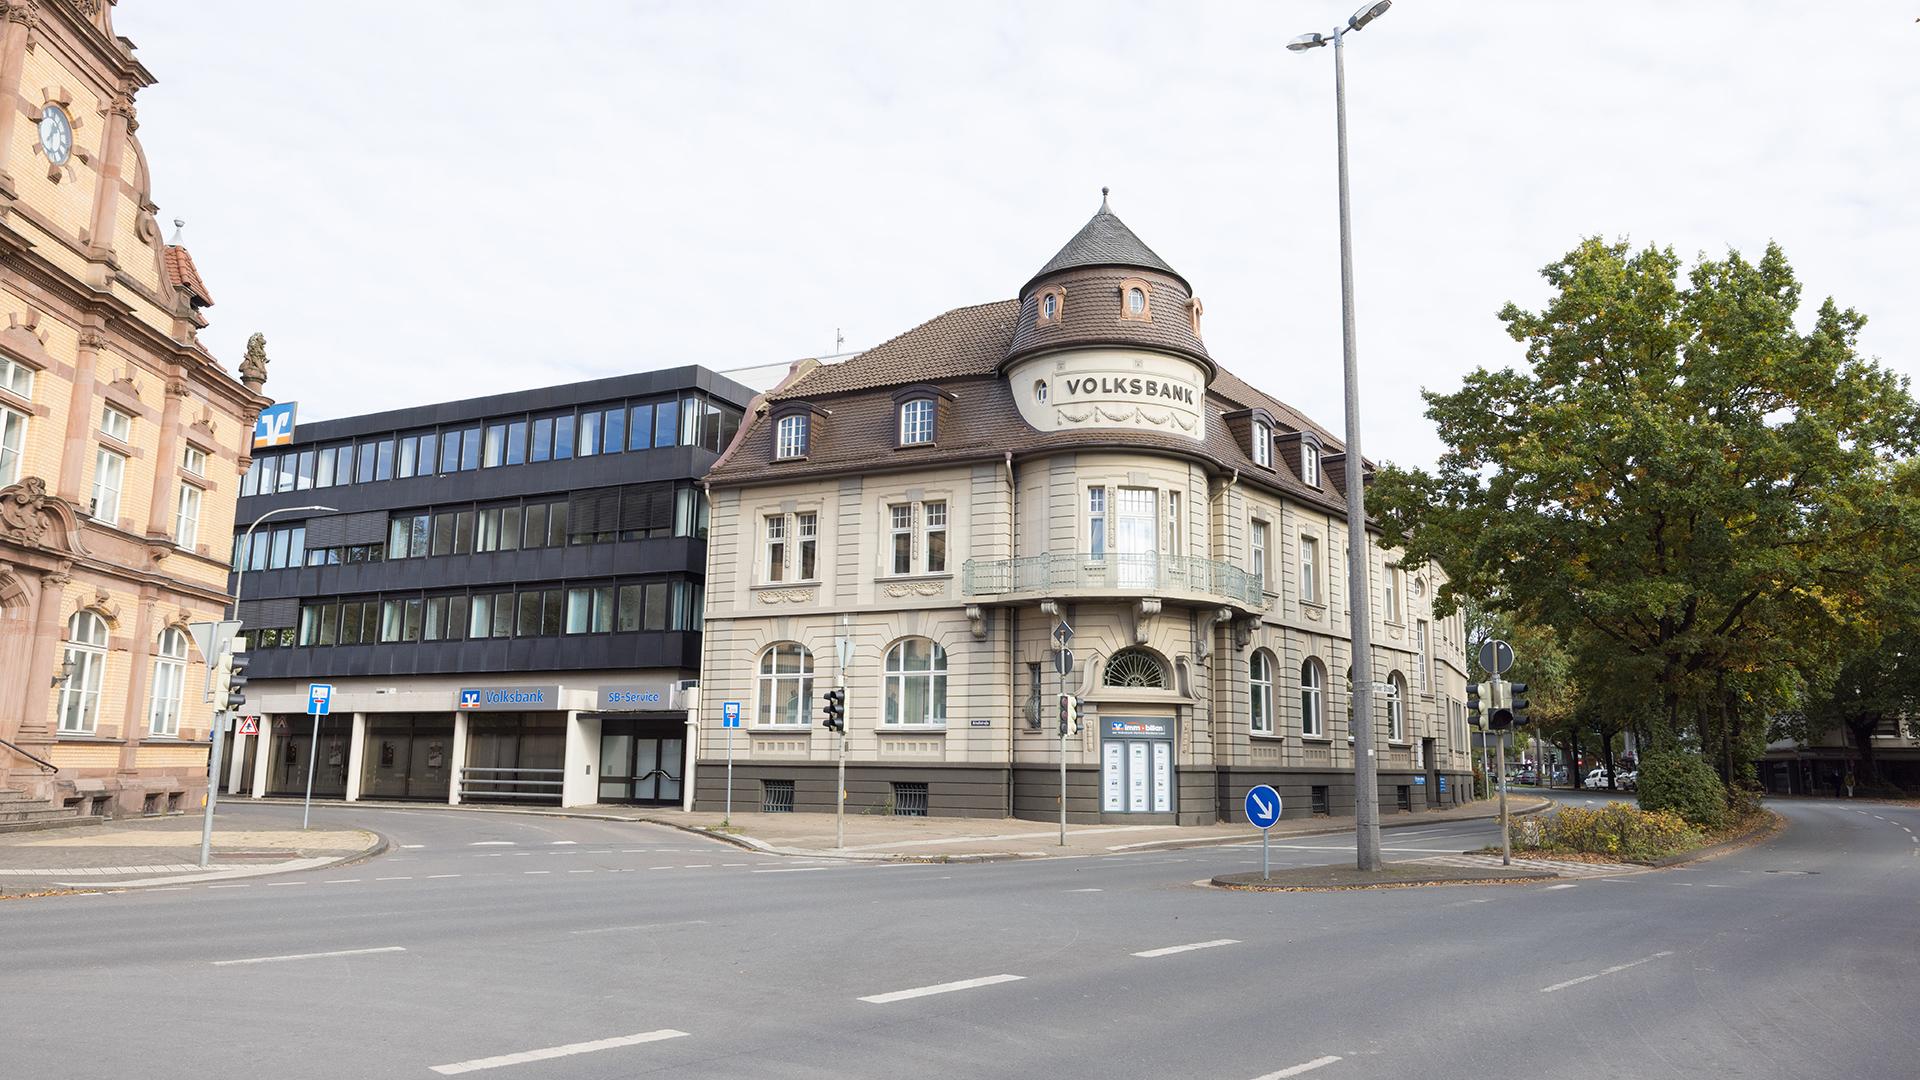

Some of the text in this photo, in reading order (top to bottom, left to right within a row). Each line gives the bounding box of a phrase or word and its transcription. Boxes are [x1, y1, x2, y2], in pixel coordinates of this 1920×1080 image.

[1066, 377, 1193, 405] VOLKSBANK
[485, 688, 545, 704] Volksbank
[608, 692, 659, 702] SB-Service
